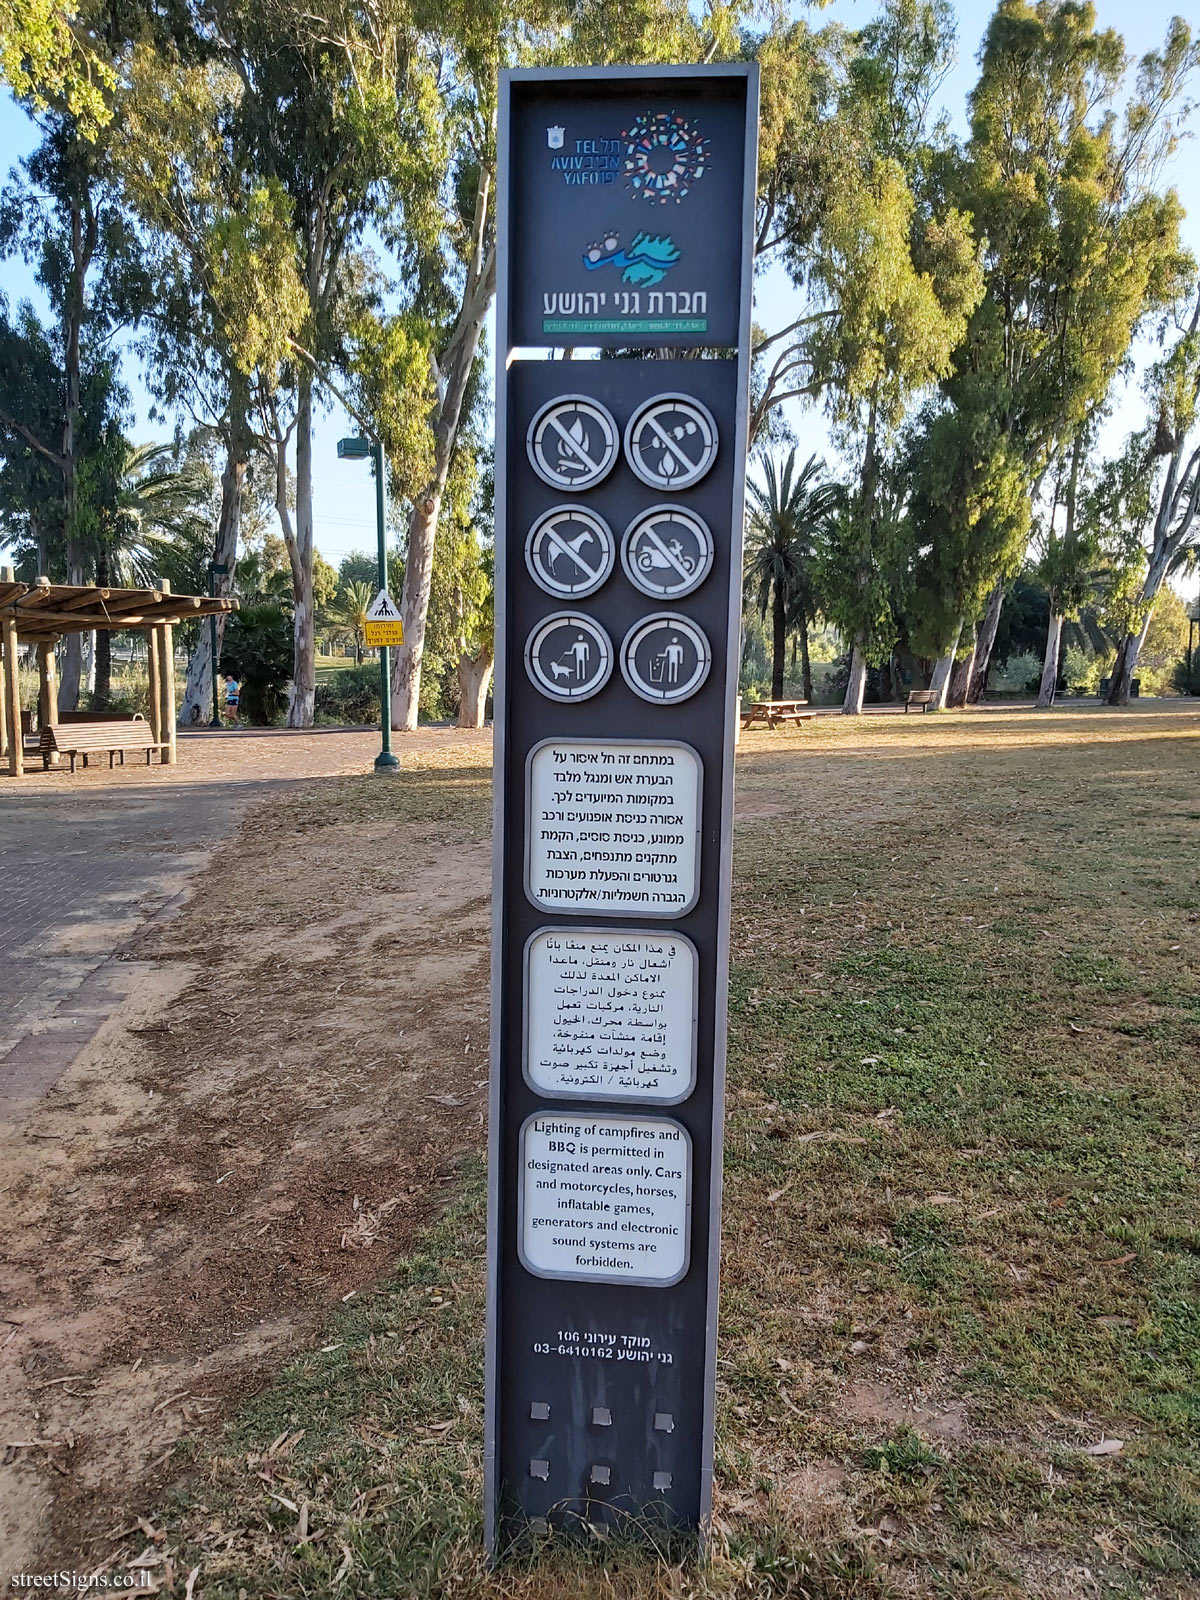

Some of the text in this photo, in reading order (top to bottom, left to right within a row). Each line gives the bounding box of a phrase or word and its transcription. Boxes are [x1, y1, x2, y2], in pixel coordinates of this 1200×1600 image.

[576, 141, 599, 153] TEL
[600, 137, 620, 152] תל
[552, 157, 583, 170] AVIV
[585, 156, 620, 168] אביב
[564, 172, 598, 184] YAFO
[543, 291, 707, 314] חברת גני יהושע
[553, 751, 674, 766] במתחם זה חל איסור על
[554, 771, 673, 785] הבערת אש ומנגל מלבד
[552, 791, 674, 806] במקומות המיועדים לכך.
[542, 811, 683, 825] אסורה כניסת אופנועים ורכב
[541, 831, 684, 844] ממונע, כניסת סוסים, הקמת
[547, 850, 677, 865] מתקנים מתנפחים, הצבת
[546, 869, 677, 883] גנרטורים והפעלת מערכות
[652, 892, 685, 903] הגברה
[591, 944, 608, 954] يمنع
[614, 944, 640, 953] المكان
[646, 945, 663, 953] هذا
[550, 955, 577, 965] ماعدا
[622, 959, 634, 968] نار
[561, 971, 660, 983] الاماكن المعدة لذلك
[554, 986, 665, 999] ممنوع دخول الدراجات
[557, 1000, 581, 1010] تعمل
[586, 1002, 624, 1012] مركبات
[554, 1015, 584, 1025] الخيول
[628, 1018, 667, 1029] بواسطة
[600, 1030, 635, 1041] منشآت
[641, 1034, 665, 1046] إقامة
[553, 1044, 666, 1060] وضع مولدات كهربائية
[575, 1061, 598, 1069] تكبير
[603, 1060, 633, 1071] أجهزة
[638, 1063, 677, 1075] وتشغيل
[619, 1078, 658, 1089] كهربائية
[535, 1122, 680, 1140] Lighting of campfires and
[549, 1141, 664, 1158] BBQ is permitted in
[528, 1160, 682, 1179] designated areas only. Cars
[536, 1179, 677, 1198] and motorcycles, horses,
[558, 1198, 654, 1216] inflatable games,
[532, 1218, 678, 1235] generators and electronic
[552, 1237, 657, 1252] sound systems are
[576, 1255, 633, 1269] forbidden.
[558, 1331, 650, 1348] מוקד עירוני 106
[534, 1343, 672, 1364] גני יהושע 03-6410162
